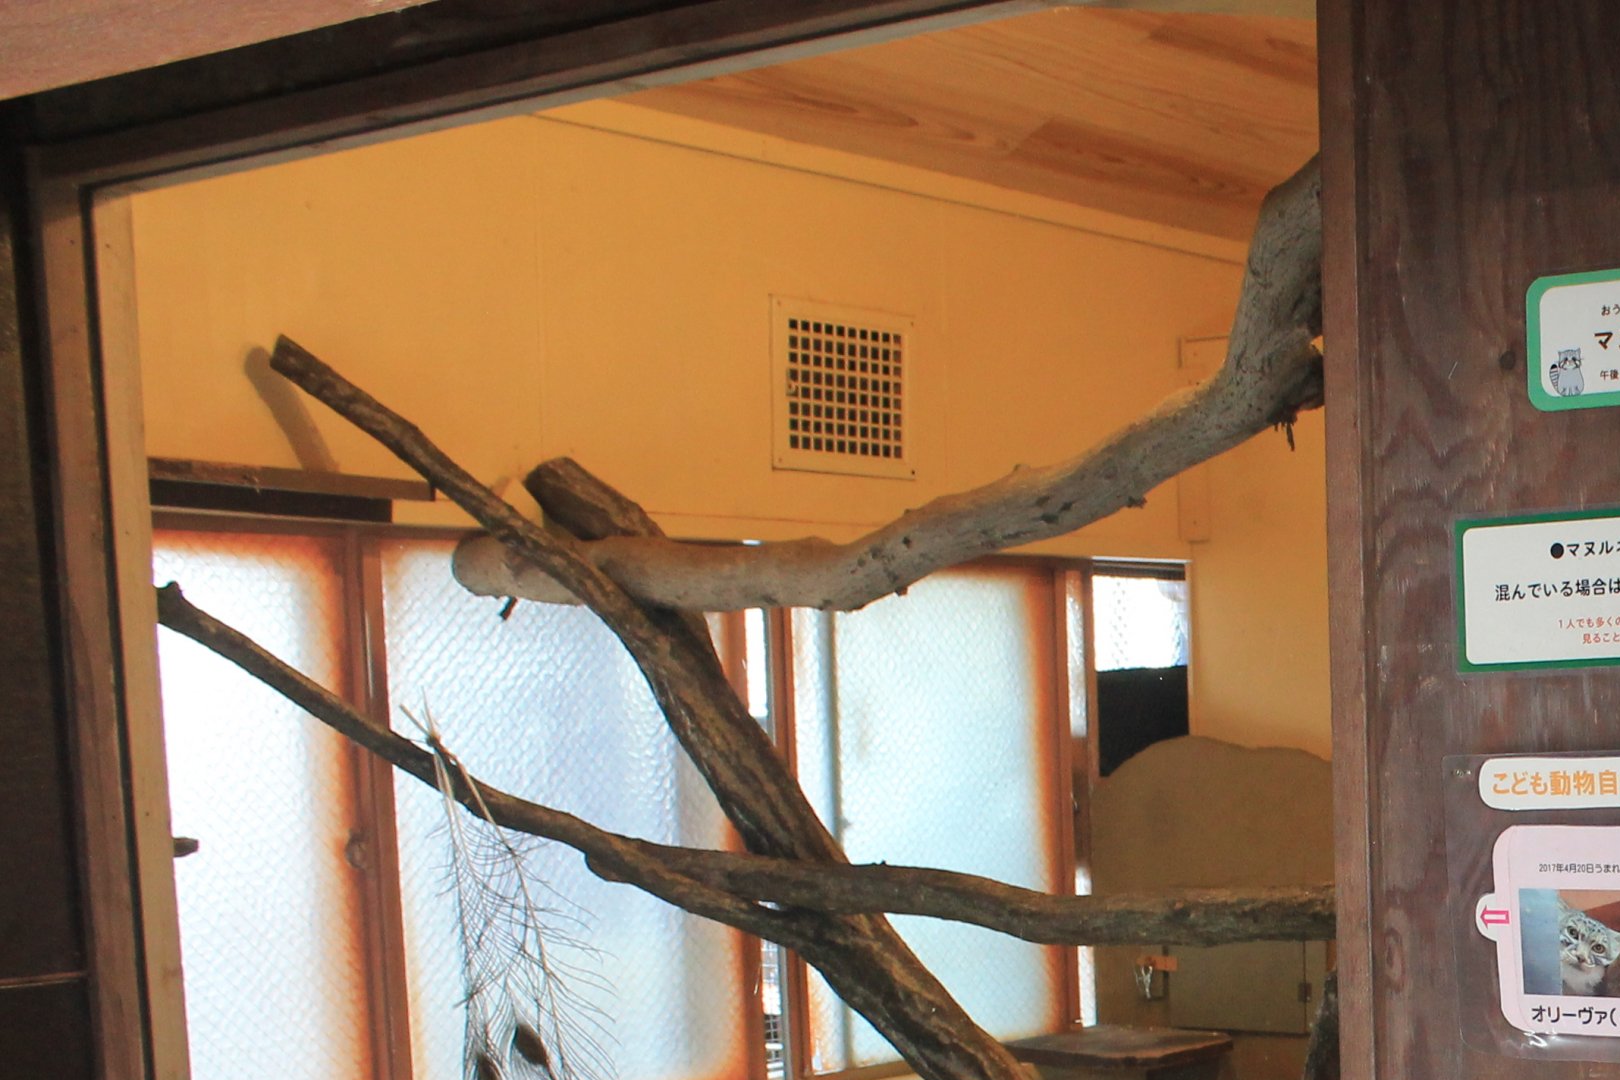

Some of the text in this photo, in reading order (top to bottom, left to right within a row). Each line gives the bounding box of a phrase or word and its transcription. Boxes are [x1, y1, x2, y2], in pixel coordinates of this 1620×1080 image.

[1538, 863, 1620, 874] 2017年4月20日うまれ
